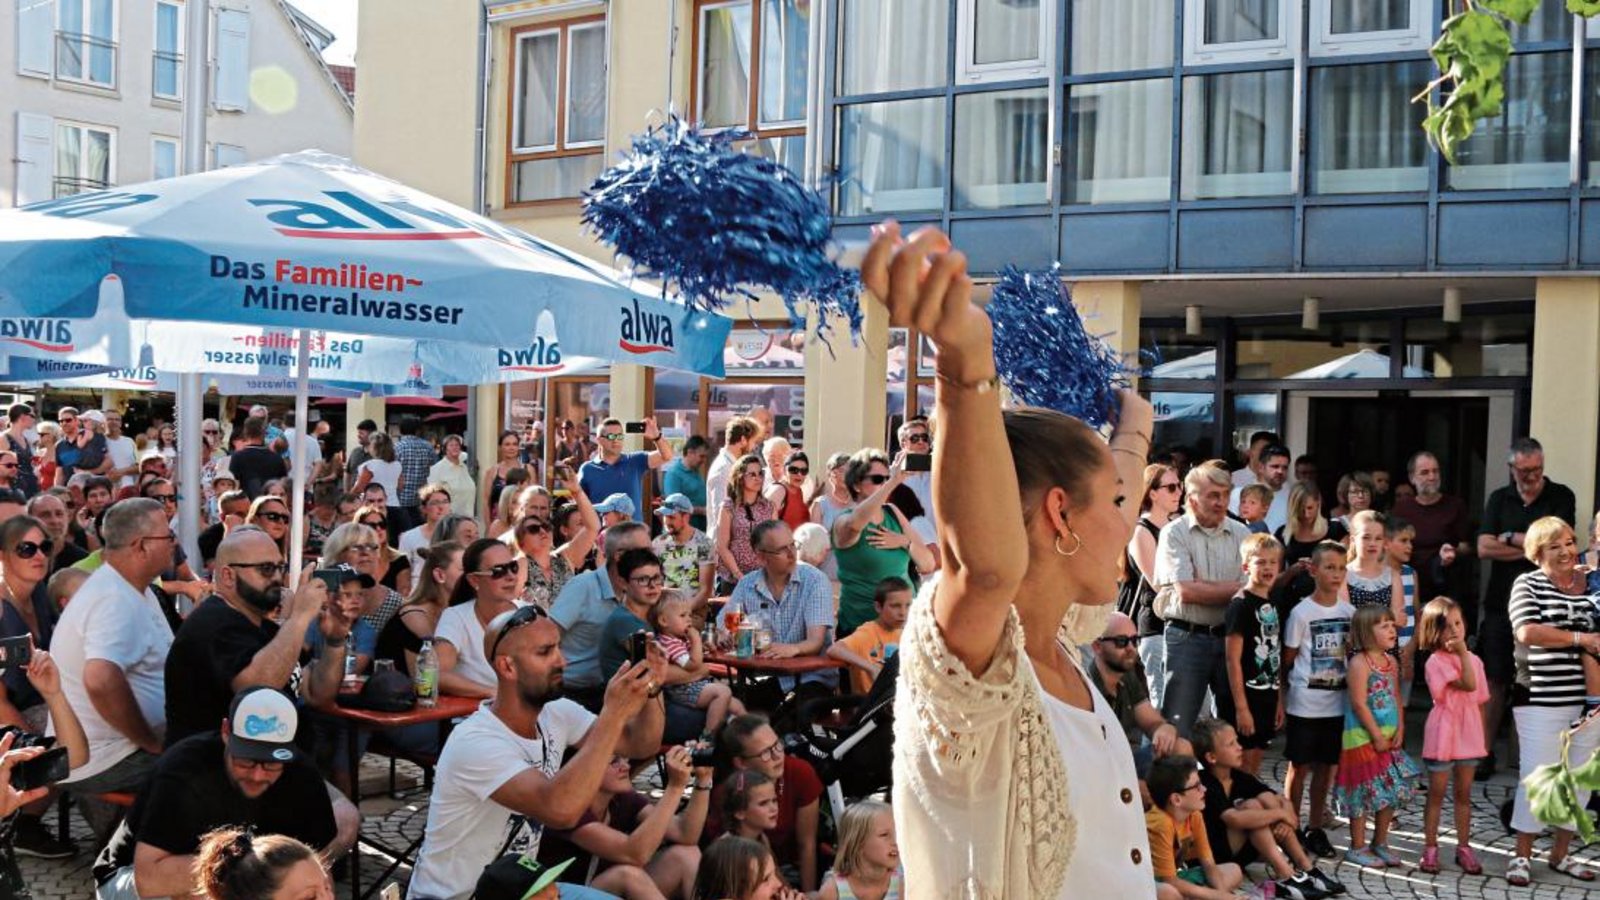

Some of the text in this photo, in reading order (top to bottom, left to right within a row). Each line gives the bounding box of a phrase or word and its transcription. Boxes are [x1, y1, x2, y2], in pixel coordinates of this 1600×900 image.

[209, 254, 266, 281] Das
[242, 284, 464, 326] Mineralwasser
[620, 298, 674, 348] alwa
